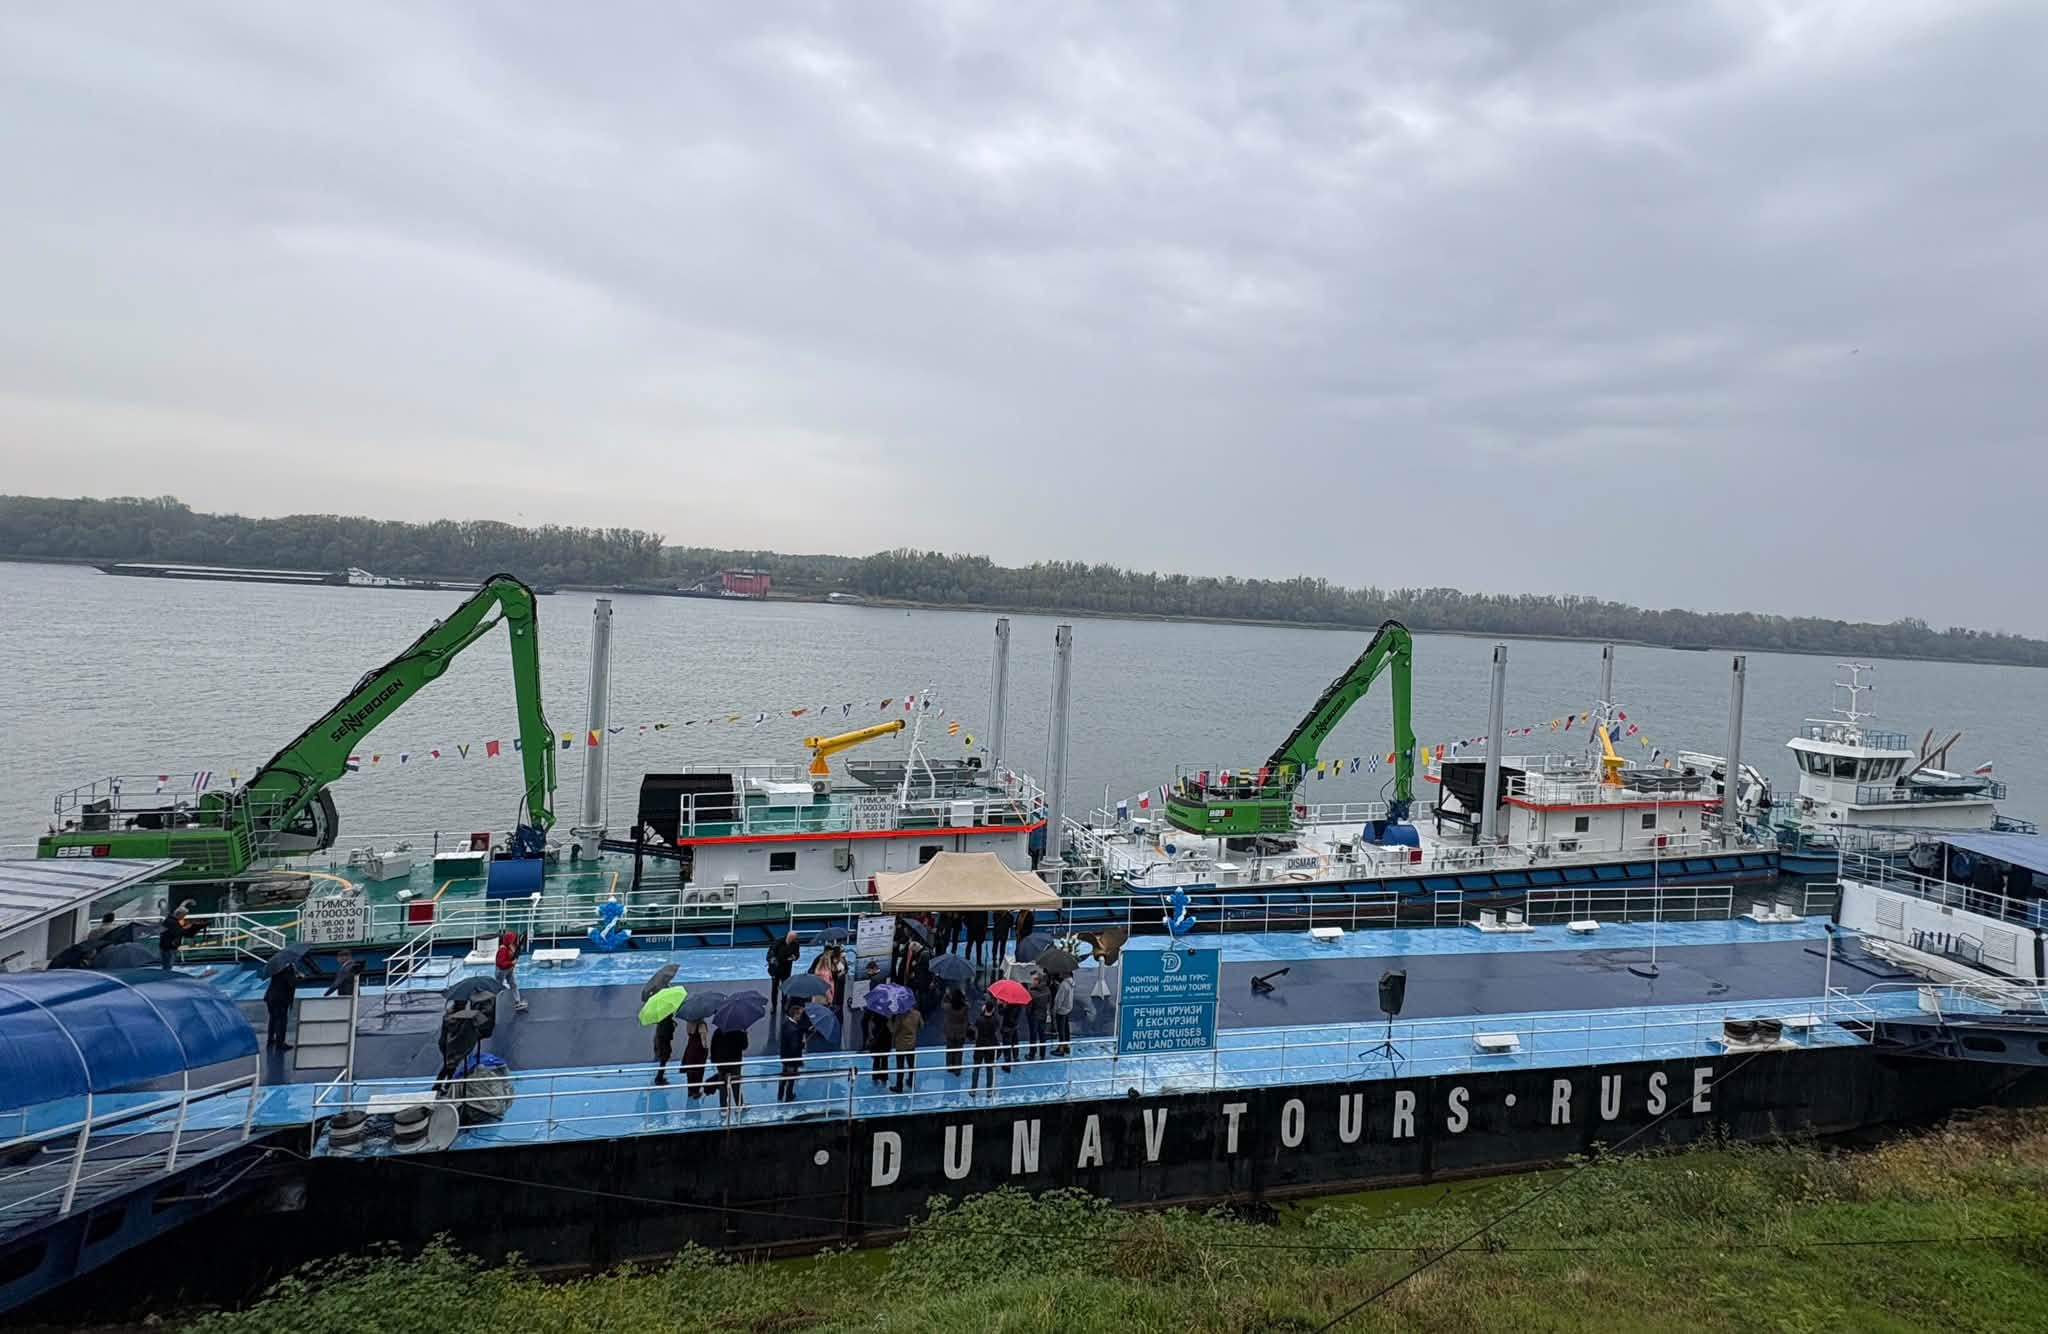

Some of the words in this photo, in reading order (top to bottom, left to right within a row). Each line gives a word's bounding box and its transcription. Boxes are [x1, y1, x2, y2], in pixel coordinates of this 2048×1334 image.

[331, 678, 404, 742] SENNEBOGEN
[314, 899, 356, 909] ТИМОК
[308, 908, 362, 918] 47000330
[1130, 975, 1159, 984] ПОНТОН
[1133, 1007, 1166, 1017] РЕЧНИ
[1167, 1005, 1203, 1016] КРУИЗИ
[1136, 1018, 1144, 1027] И
[1145, 1016, 1199, 1027] ЕКСКУРЗИИ
[1132, 1029, 1160, 1040] RIVER
[1162, 1027, 1201, 1038] CRUISES
[1126, 1041, 1146, 1051] AND
[1148, 1039, 1173, 1049] LAND
[1175, 1037, 1206, 1047] TOURS
[871, 1108, 1169, 1187] DUNAV
[1221, 1086, 1470, 1154] TOURS
[1551, 1067, 1714, 1125] RUSE
